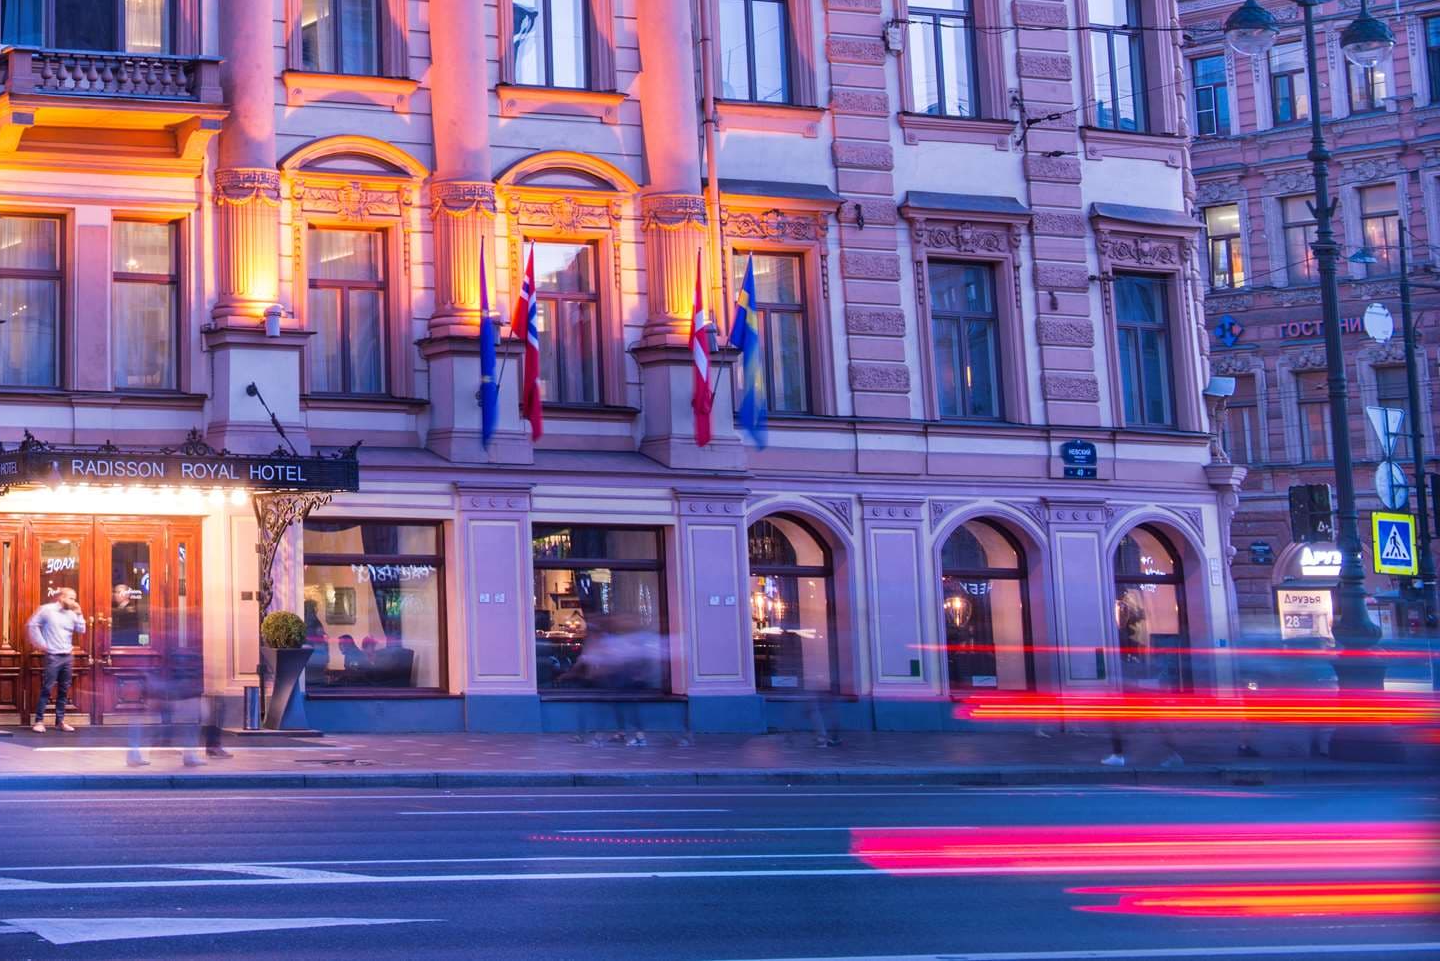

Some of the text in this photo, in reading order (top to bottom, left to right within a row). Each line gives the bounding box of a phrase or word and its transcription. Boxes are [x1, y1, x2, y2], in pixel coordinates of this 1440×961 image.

[1279, 318, 1362, 338] ГОСТНИ
[0, 461, 18, 475] HOTEL
[72, 459, 308, 482] RADISSON ROYAL HOTEL
[1285, 615, 1301, 628] 28
